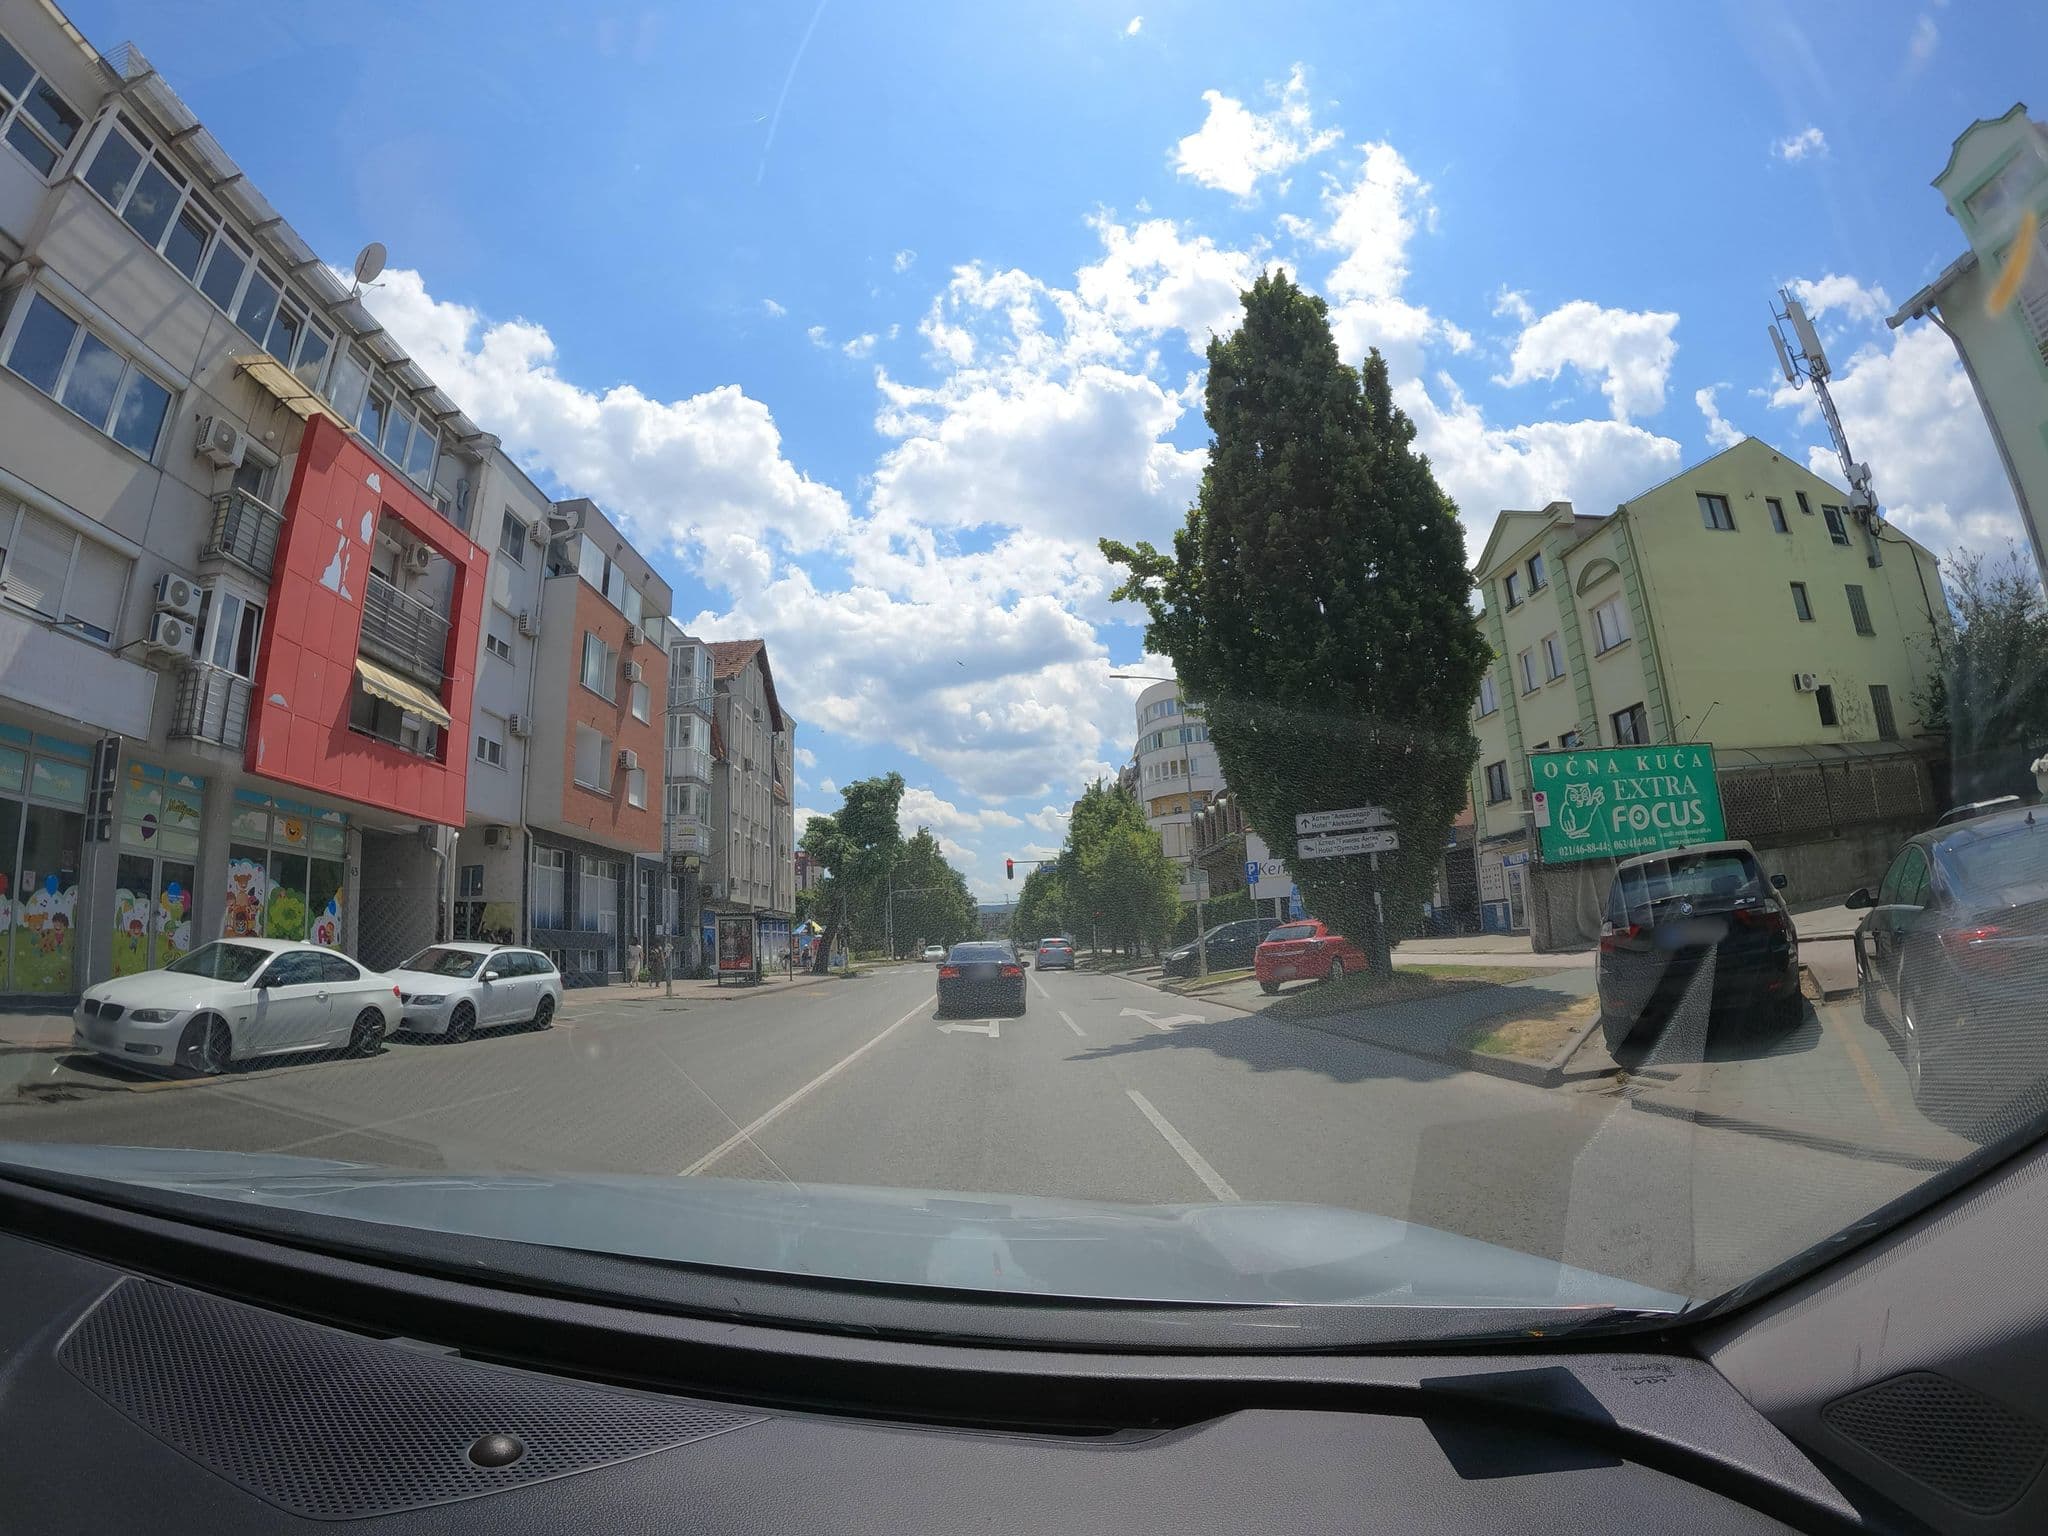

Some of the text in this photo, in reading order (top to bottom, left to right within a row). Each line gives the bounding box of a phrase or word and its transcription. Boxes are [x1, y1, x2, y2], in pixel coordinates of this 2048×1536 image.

[1544, 750, 1703, 778] OČNA KUĆA
[1612, 775, 1698, 801] EXTRA
[1311, 822, 1328, 830] Hotel
[1612, 800, 1705, 832] FOCUS
